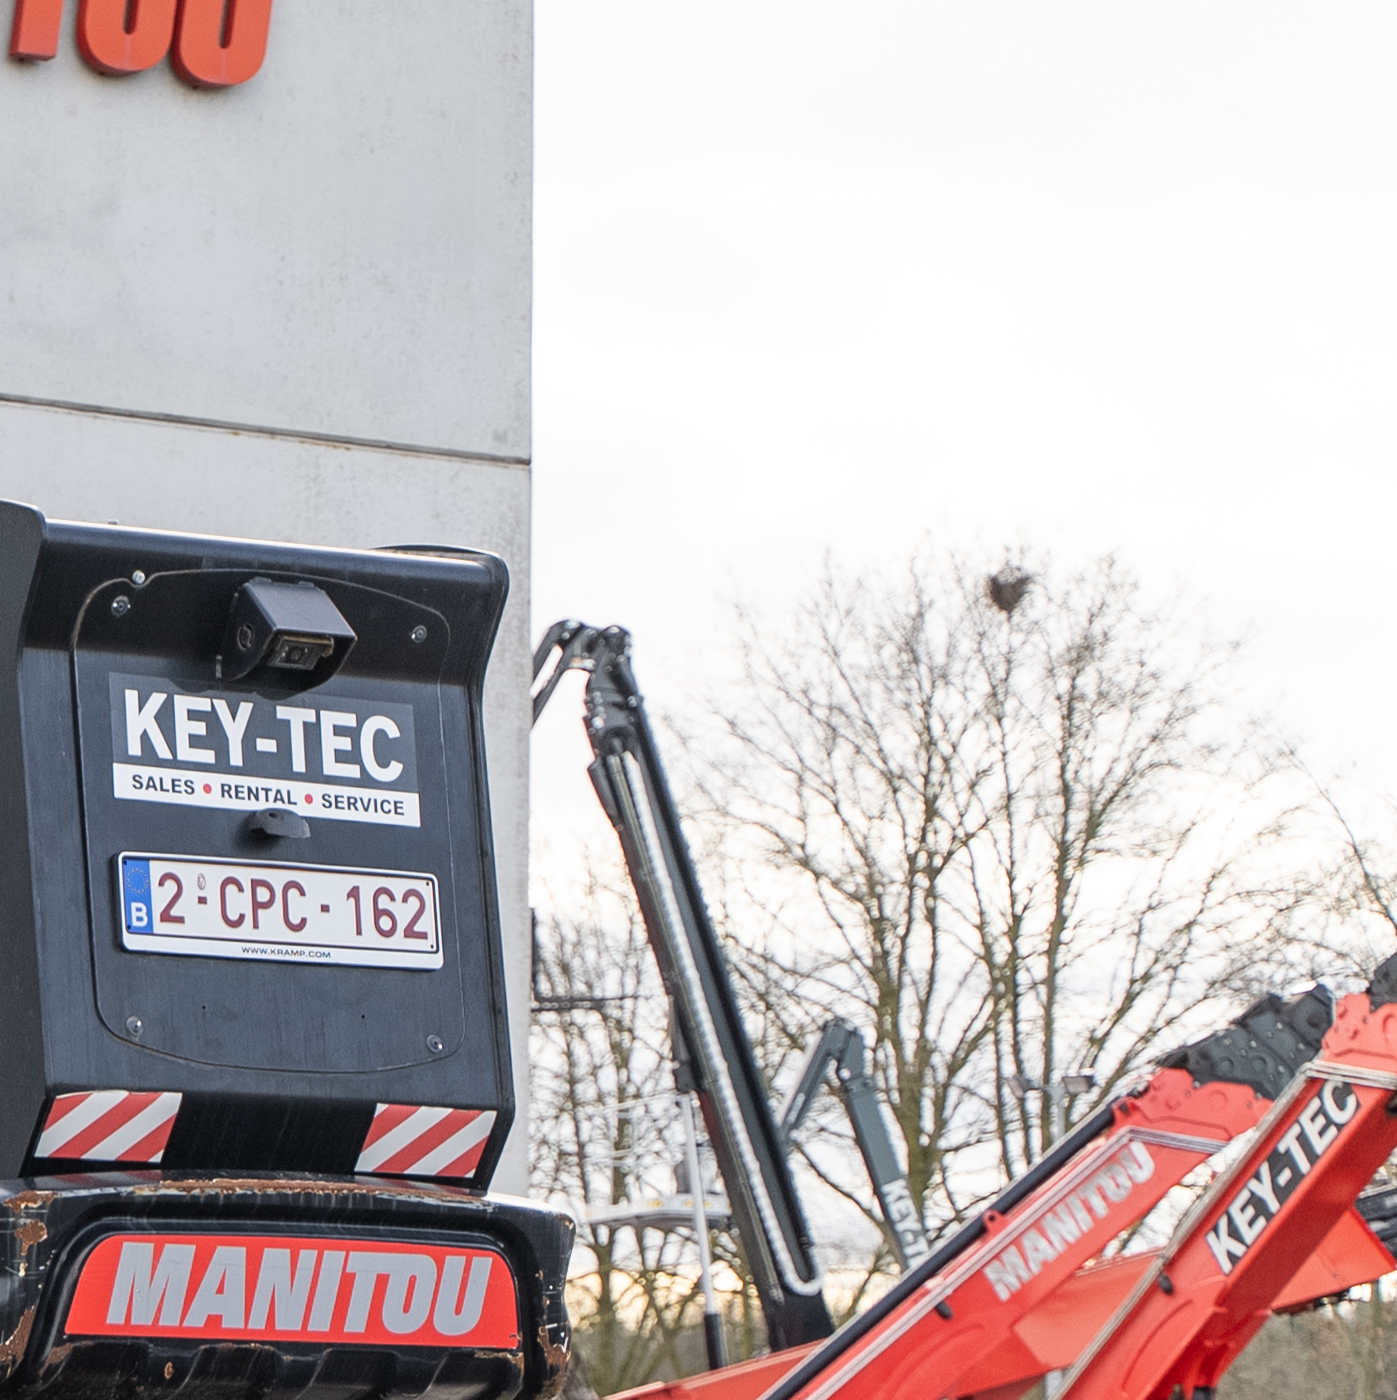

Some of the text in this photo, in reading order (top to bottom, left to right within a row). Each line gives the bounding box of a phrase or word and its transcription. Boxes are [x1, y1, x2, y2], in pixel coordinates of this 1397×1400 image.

[124, 688, 404, 781] KEY-TEC
[131, 774, 406, 816] SALES RENTAL SERVICE
[129, 902, 149, 927] B
[241, 946, 332, 959] WWW.KRAMP.COM
[982, 1141, 1156, 1301] MANITOU
[1204, 1082, 1362, 1275] KEY-TEC
[105, 1241, 493, 1337] MANITOU
